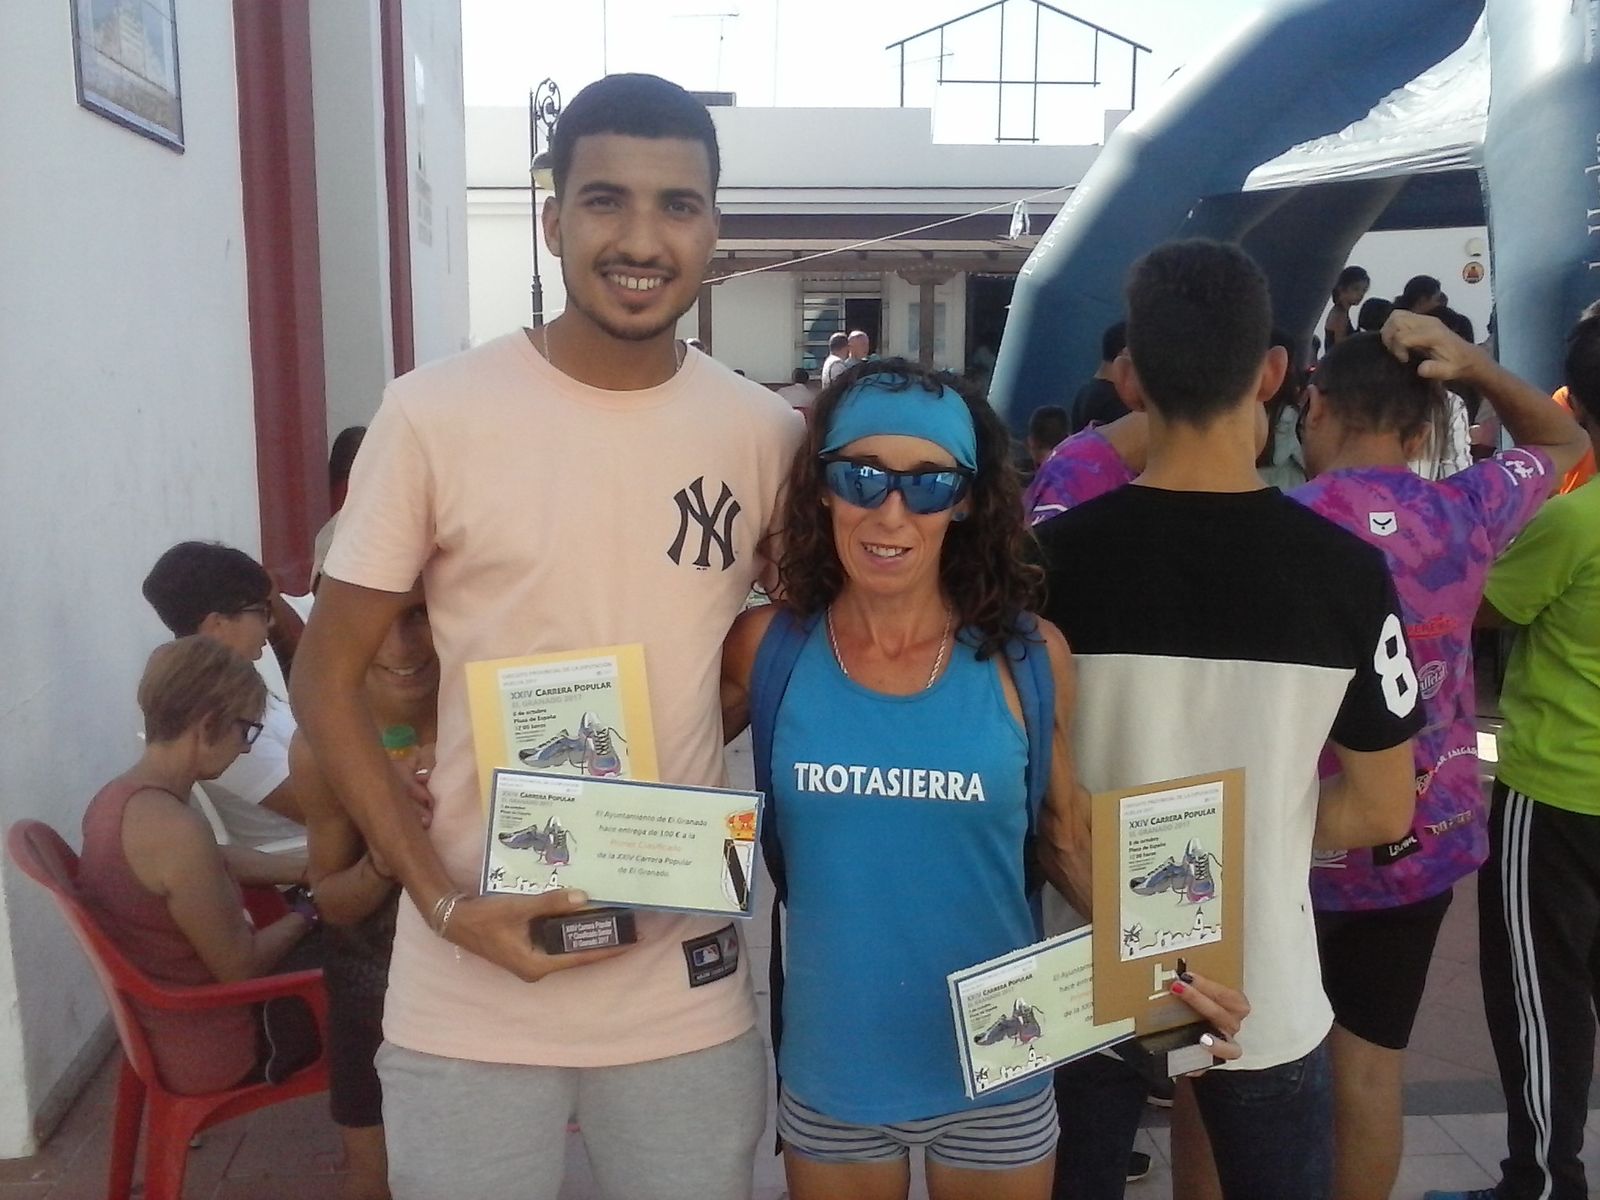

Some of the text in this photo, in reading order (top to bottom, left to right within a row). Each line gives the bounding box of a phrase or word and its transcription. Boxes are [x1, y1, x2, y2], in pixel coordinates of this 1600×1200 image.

[667, 476, 741, 571] NY
[1374, 612, 1419, 719] 8
[510, 681, 612, 700] XXIV CARRERA POPULAR
[794, 762, 986, 801] TROTASIERRA
[520, 791, 547, 800] CARRERA
[548, 794, 575, 802] POPULAR
[604, 811, 655, 822] Ayuntamiento
[677, 817, 708, 826] Granado
[1129, 808, 1216, 829] XXIV CARRERA POPULAR
[618, 827, 647, 836] entrega
[660, 830, 675, 838] 100
[635, 855, 663, 863] Carrera
[664, 857, 692, 866] Popular
[638, 868, 669, 877] Granado
[983, 983, 1007, 996] CARRERA
[1008, 974, 1033, 986] POPULAR
